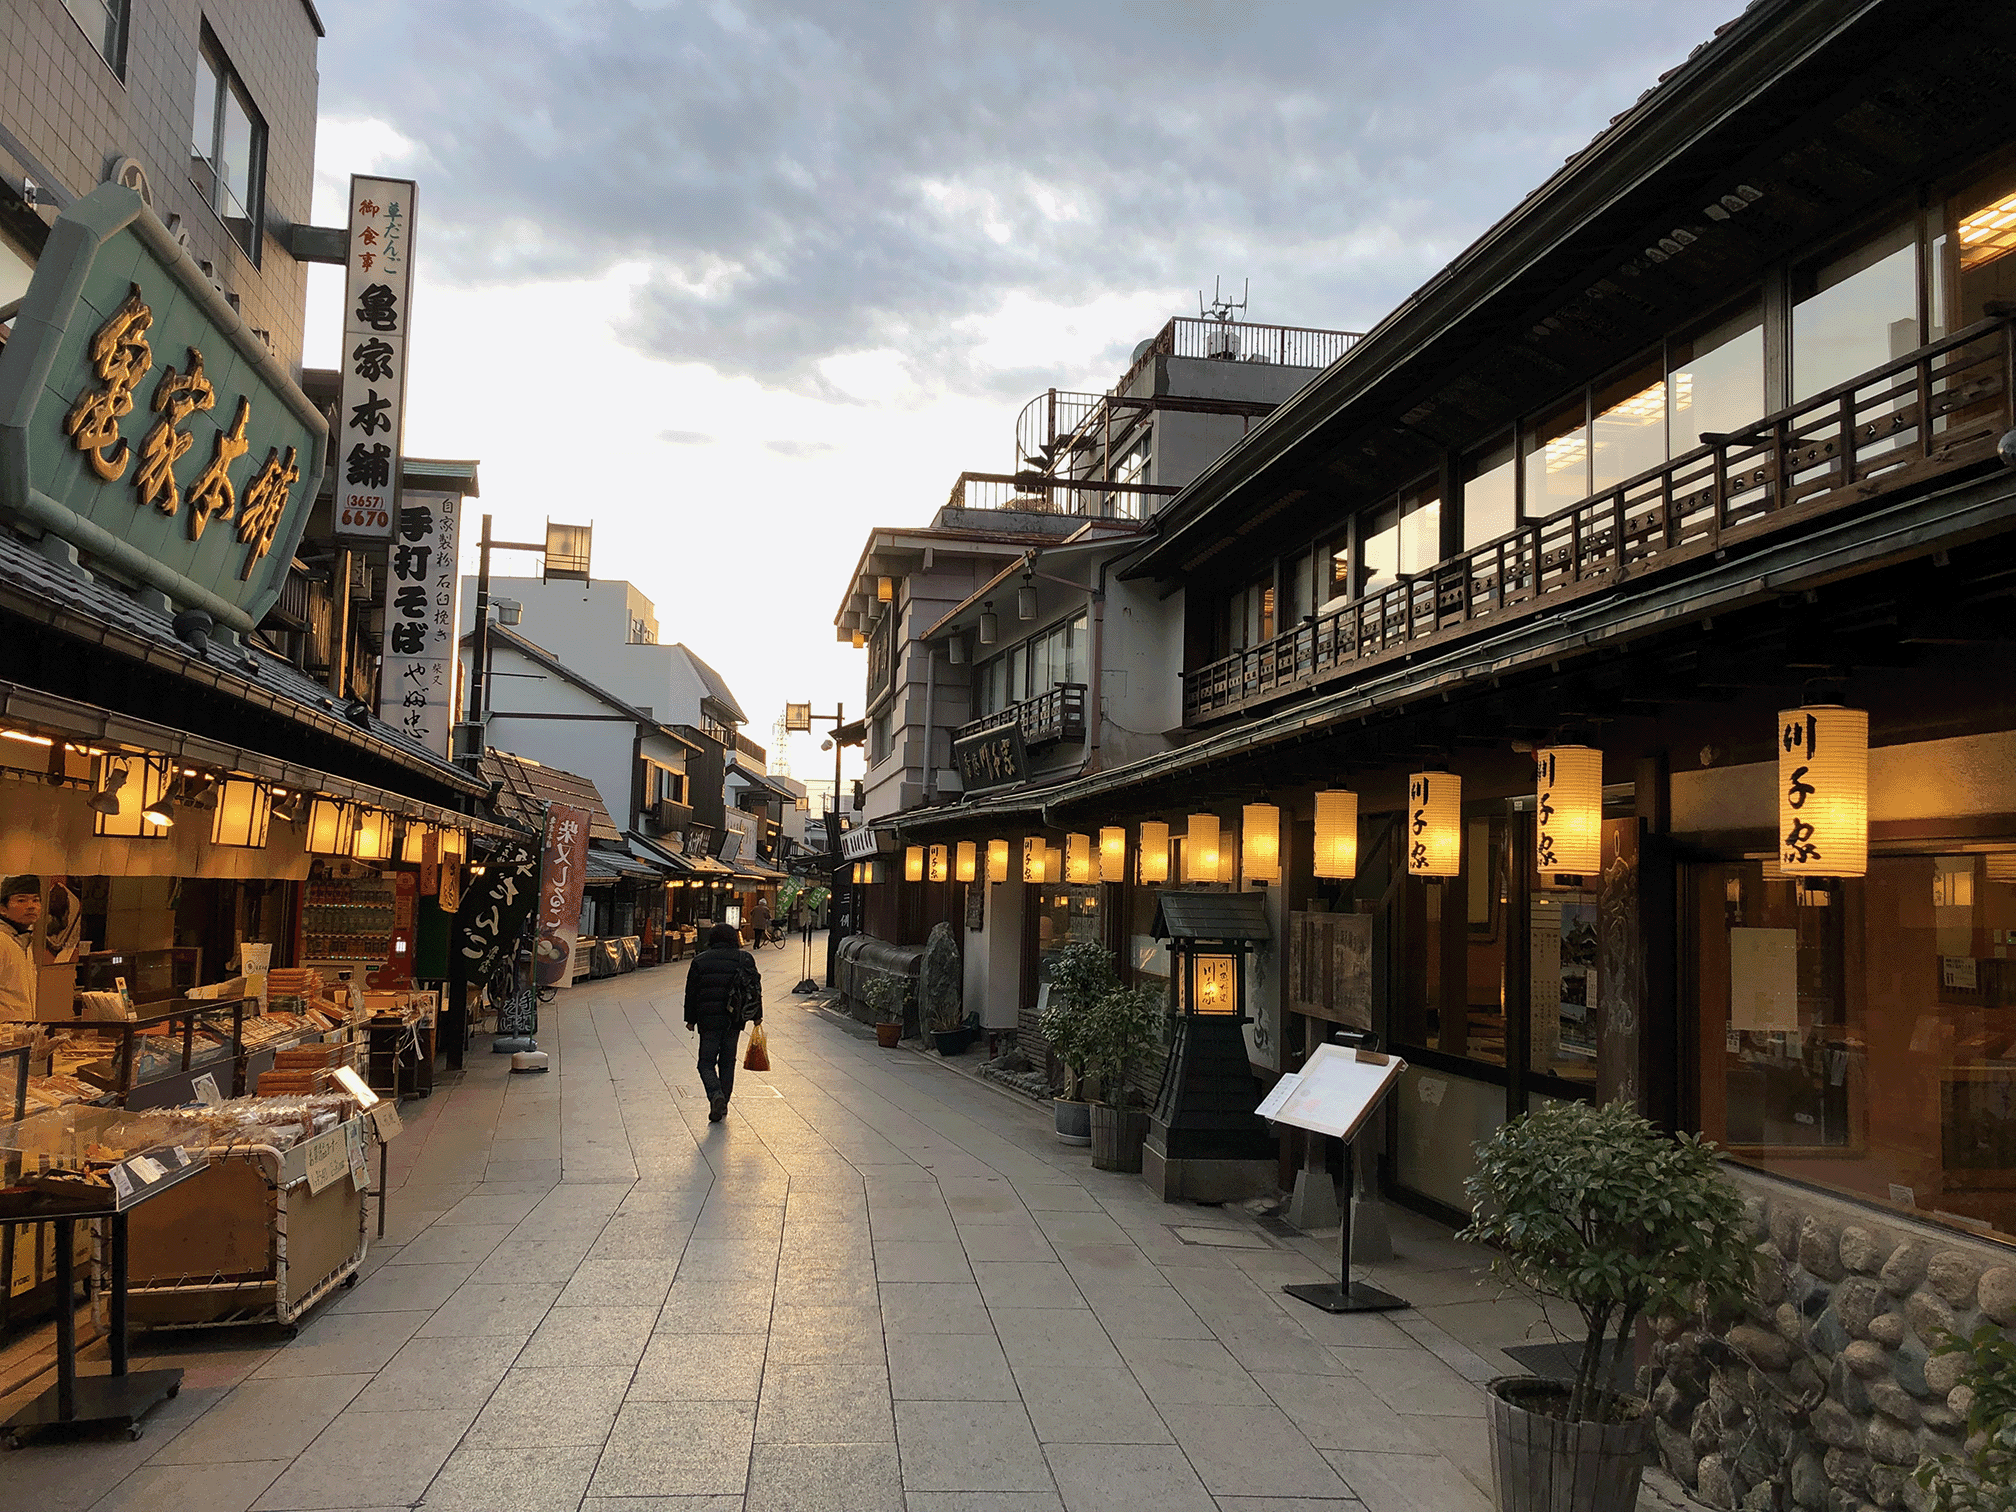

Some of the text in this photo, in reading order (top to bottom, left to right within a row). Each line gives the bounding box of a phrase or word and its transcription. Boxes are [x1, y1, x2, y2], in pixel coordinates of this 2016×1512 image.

[358, 198, 380, 273] 御食事
[383, 201, 402, 274] 草だんご
[346, 283, 398, 489] 亀家本舗
[341, 509, 389, 528] 6670
[346, 495, 385, 509] (3657)
[436, 498, 455, 568] 自家製粉
[391, 505, 433, 655] 手打そば
[546, 819, 579, 928] 柴又しるこ
